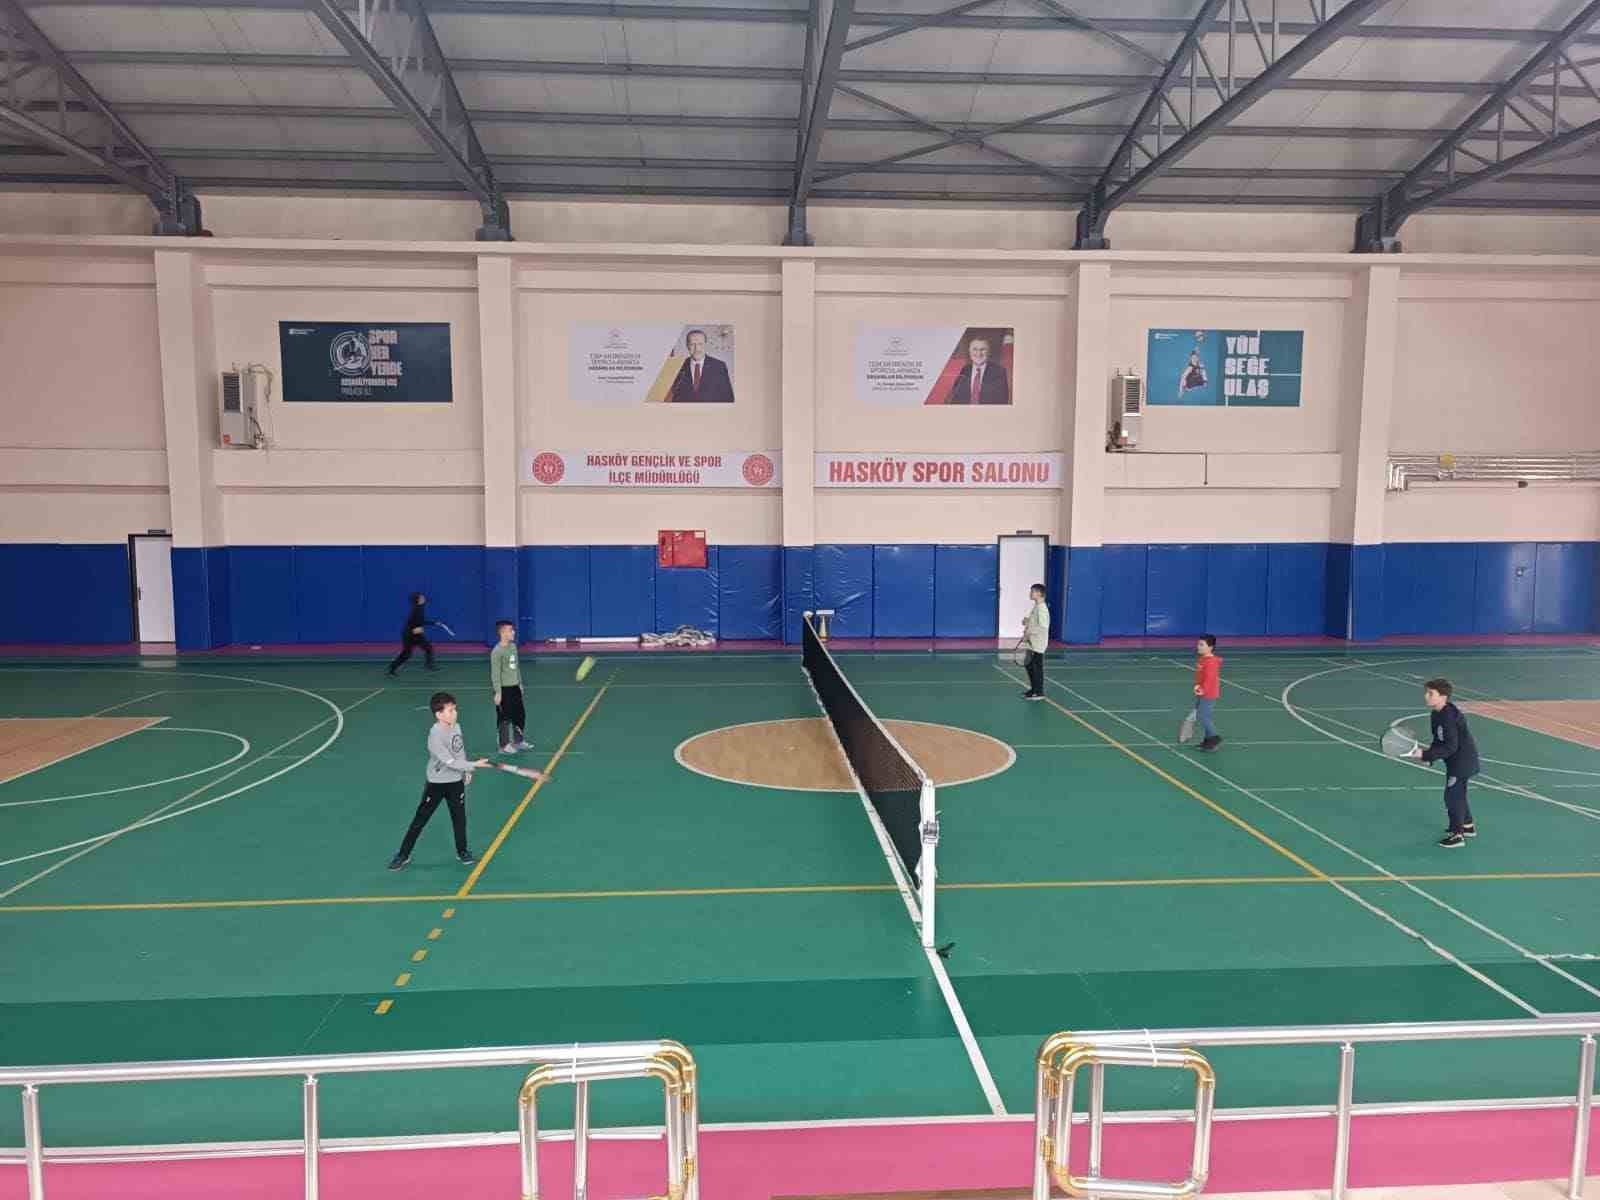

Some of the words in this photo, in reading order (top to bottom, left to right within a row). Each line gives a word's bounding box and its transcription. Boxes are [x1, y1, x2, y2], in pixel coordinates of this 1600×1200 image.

[587, 453, 629, 467] HASKÖY
[631, 453, 676, 468] GENÇLİK
[679, 456, 691, 467] VE
[693, 456, 722, 467] SPOR
[608, 469, 632, 484] İLÇE
[634, 470, 700, 484] MÜDÜRLÜĞÜ
[829, 458, 907, 483] HASKÖY
[912, 462, 965, 483] SPOR
[971, 462, 1050, 483] SALONU
